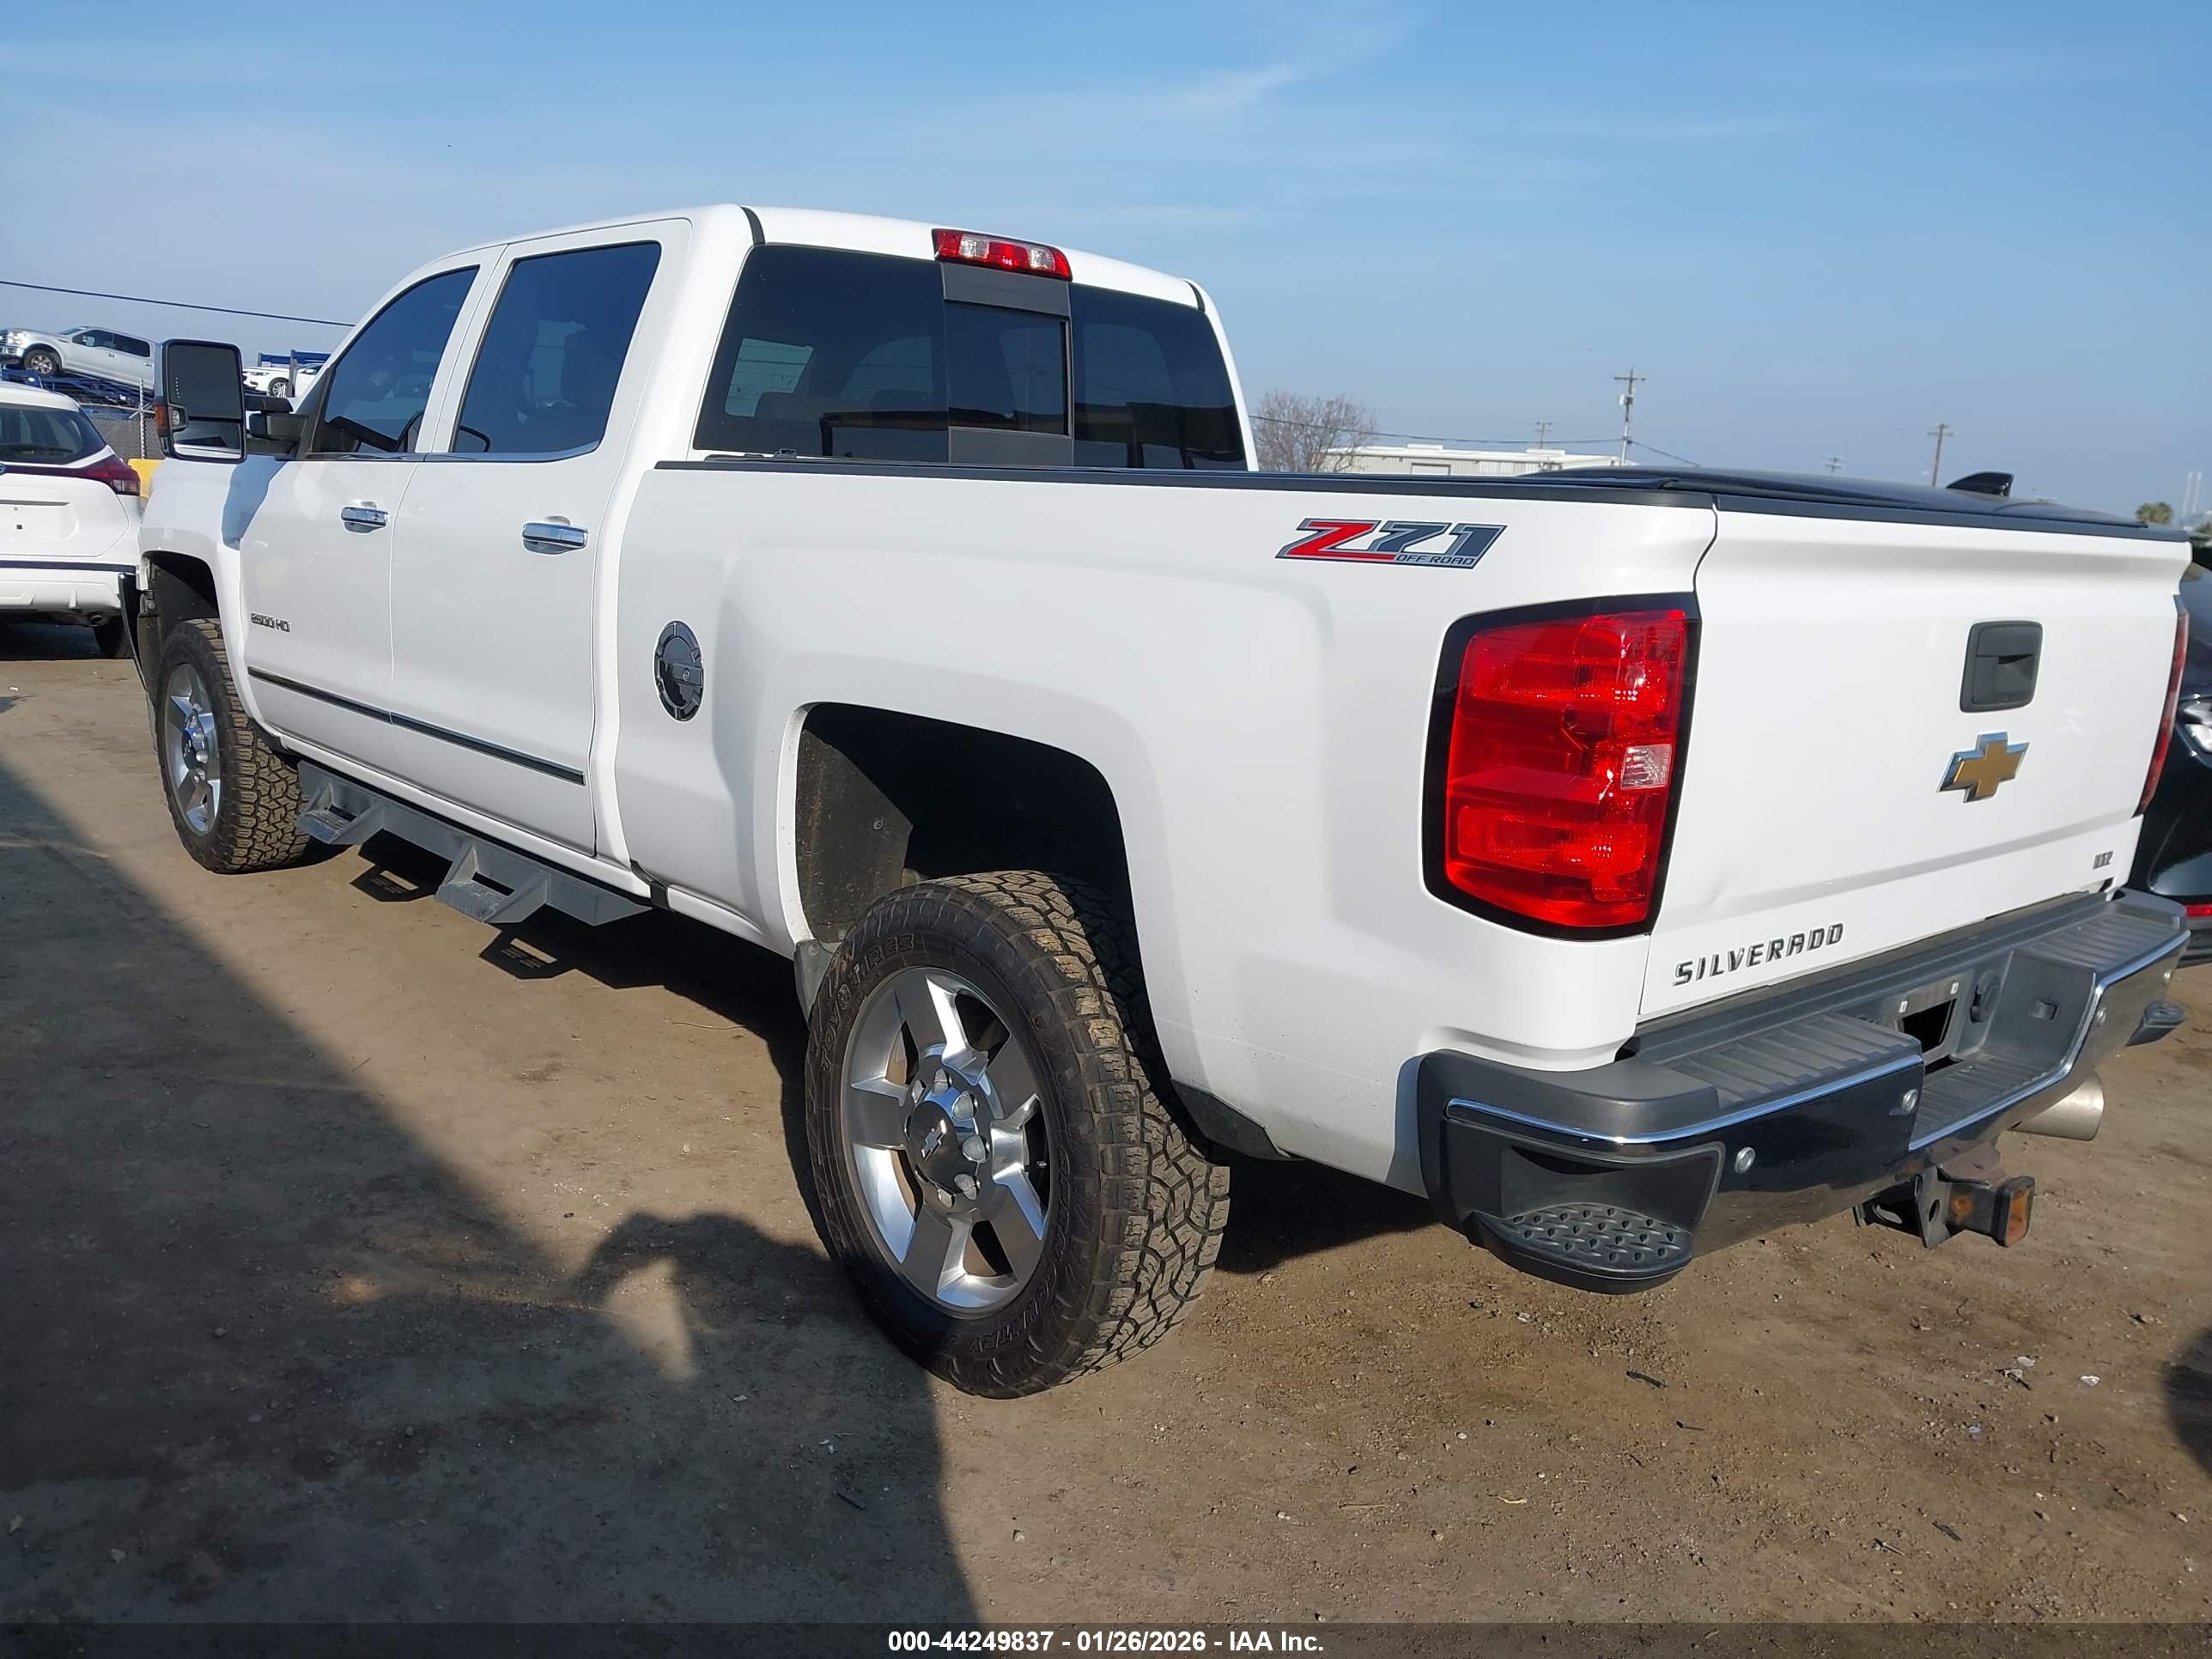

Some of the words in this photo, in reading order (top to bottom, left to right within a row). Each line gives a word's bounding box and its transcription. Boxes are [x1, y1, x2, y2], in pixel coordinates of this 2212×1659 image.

[1275, 518, 1508, 568] Z71
[1396, 554, 1427, 562] OFF
[1429, 556, 1475, 565] ROAD
[1672, 922, 1844, 987] SILVERADO
[821, 982, 852, 1073] TOYO
[853, 931, 915, 987] TIRES
